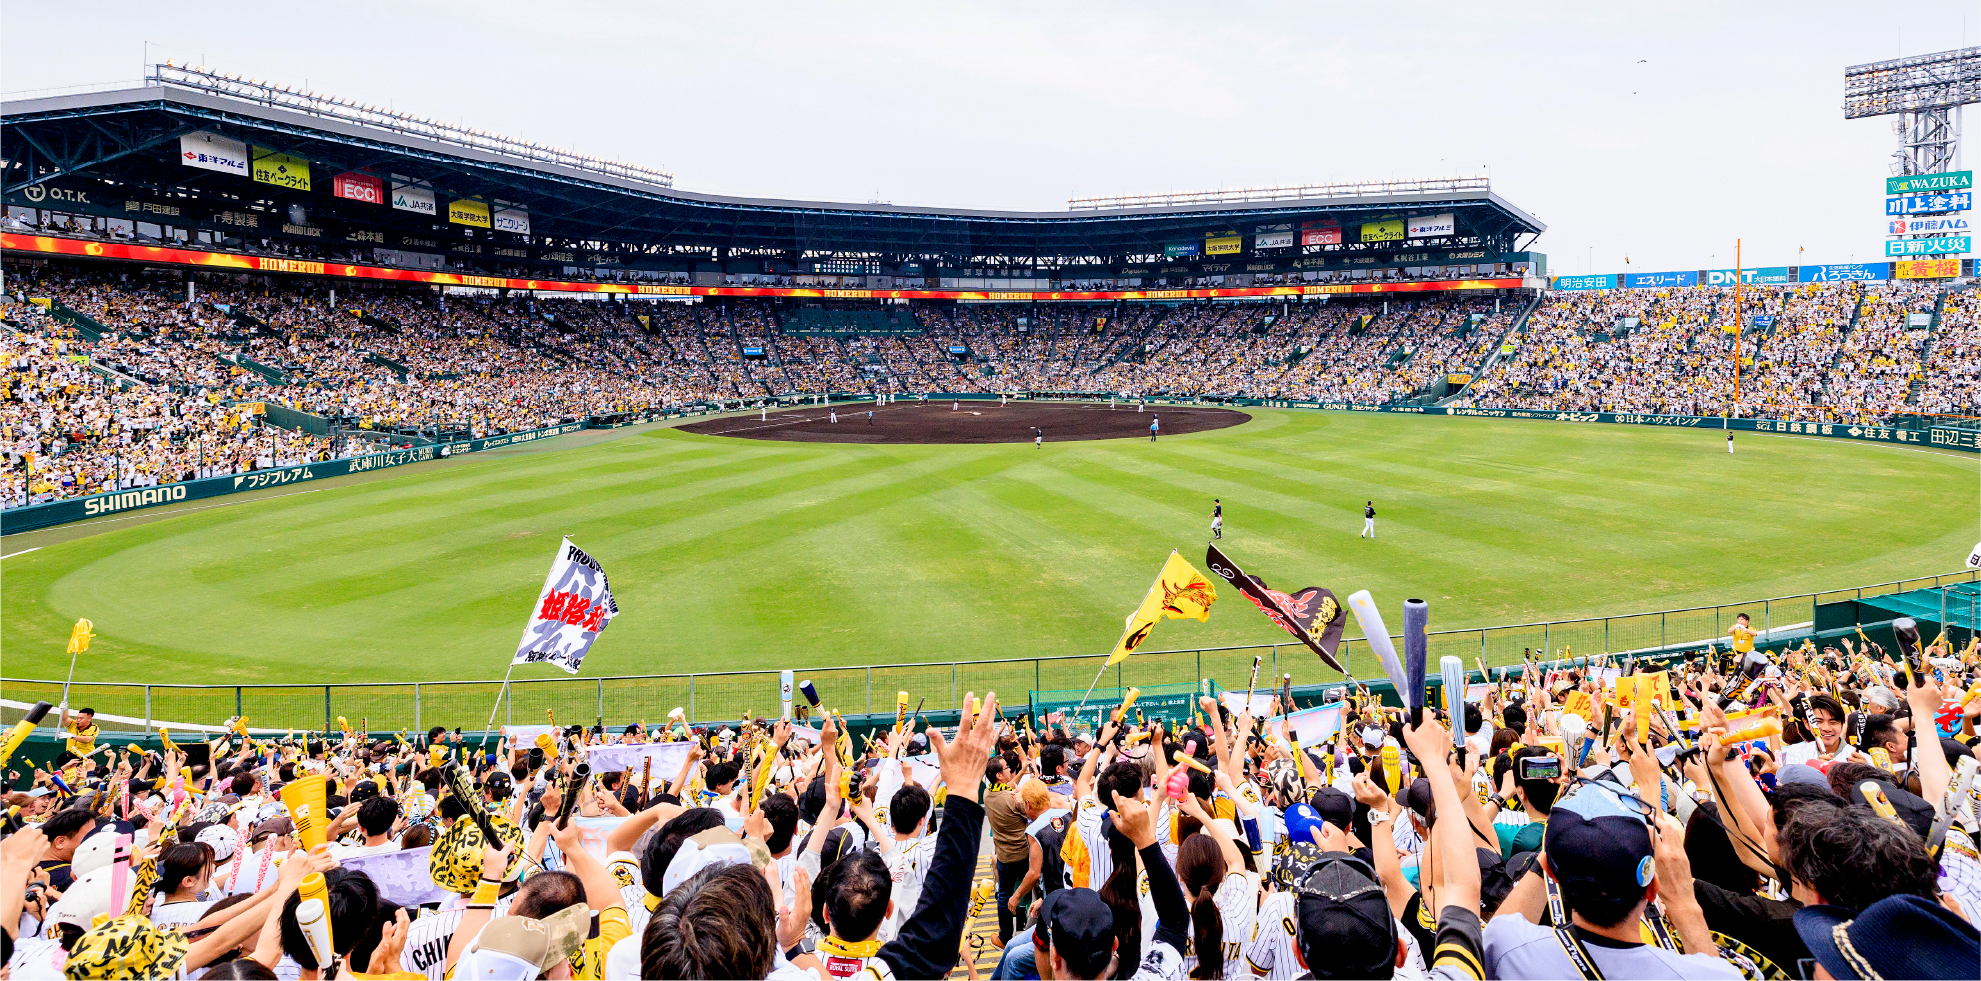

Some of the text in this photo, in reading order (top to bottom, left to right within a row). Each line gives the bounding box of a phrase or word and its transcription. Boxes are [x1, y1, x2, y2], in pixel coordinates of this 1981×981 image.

[198, 153, 244, 169] 東洋アルミ
[255, 168, 309, 190] 住友ベークライト
[1909, 175, 1969, 190] WAZUKA
[50, 187, 91, 203] O.T.K.
[344, 183, 375, 201] ECC
[1888, 193, 1970, 213] 川上塗料
[450, 210, 489, 224] 大阪学院大学
[496, 217, 528, 232] サニクリーン
[1419, 224, 1452, 233] 東洋アルミ
[1909, 218, 1968, 232] 伊藤ハム
[1308, 233, 1333, 245] ECC
[1362, 230, 1403, 241] 住友ベークライト
[1889, 237, 1966, 255] 日新火災
[259, 257, 325, 274] HOMERUN
[1909, 260, 1958, 277] 黄桜
[461, 274, 507, 288] HOMERUN
[1560, 276, 1607, 289] 明治安田
[1635, 274, 1686, 285] エスリード
[1828, 270, 1876, 281] ろうきん
[637, 285, 691, 295] HOMERUN
[823, 289, 872, 298] HOMERUN
[988, 292, 1033, 300] HOMERUN
[1145, 290, 1188, 298] HOMERUN
[1303, 284, 1352, 295] HOMERUN
[1626, 414, 1702, 427] 日本ハウズイング
[1776, 421, 1833, 435] 日鉄鋼板
[348, 449, 418, 472] 武庫川女子大
[248, 467, 313, 488] フジプレアム
[84, 485, 187, 515] SHIMANO
